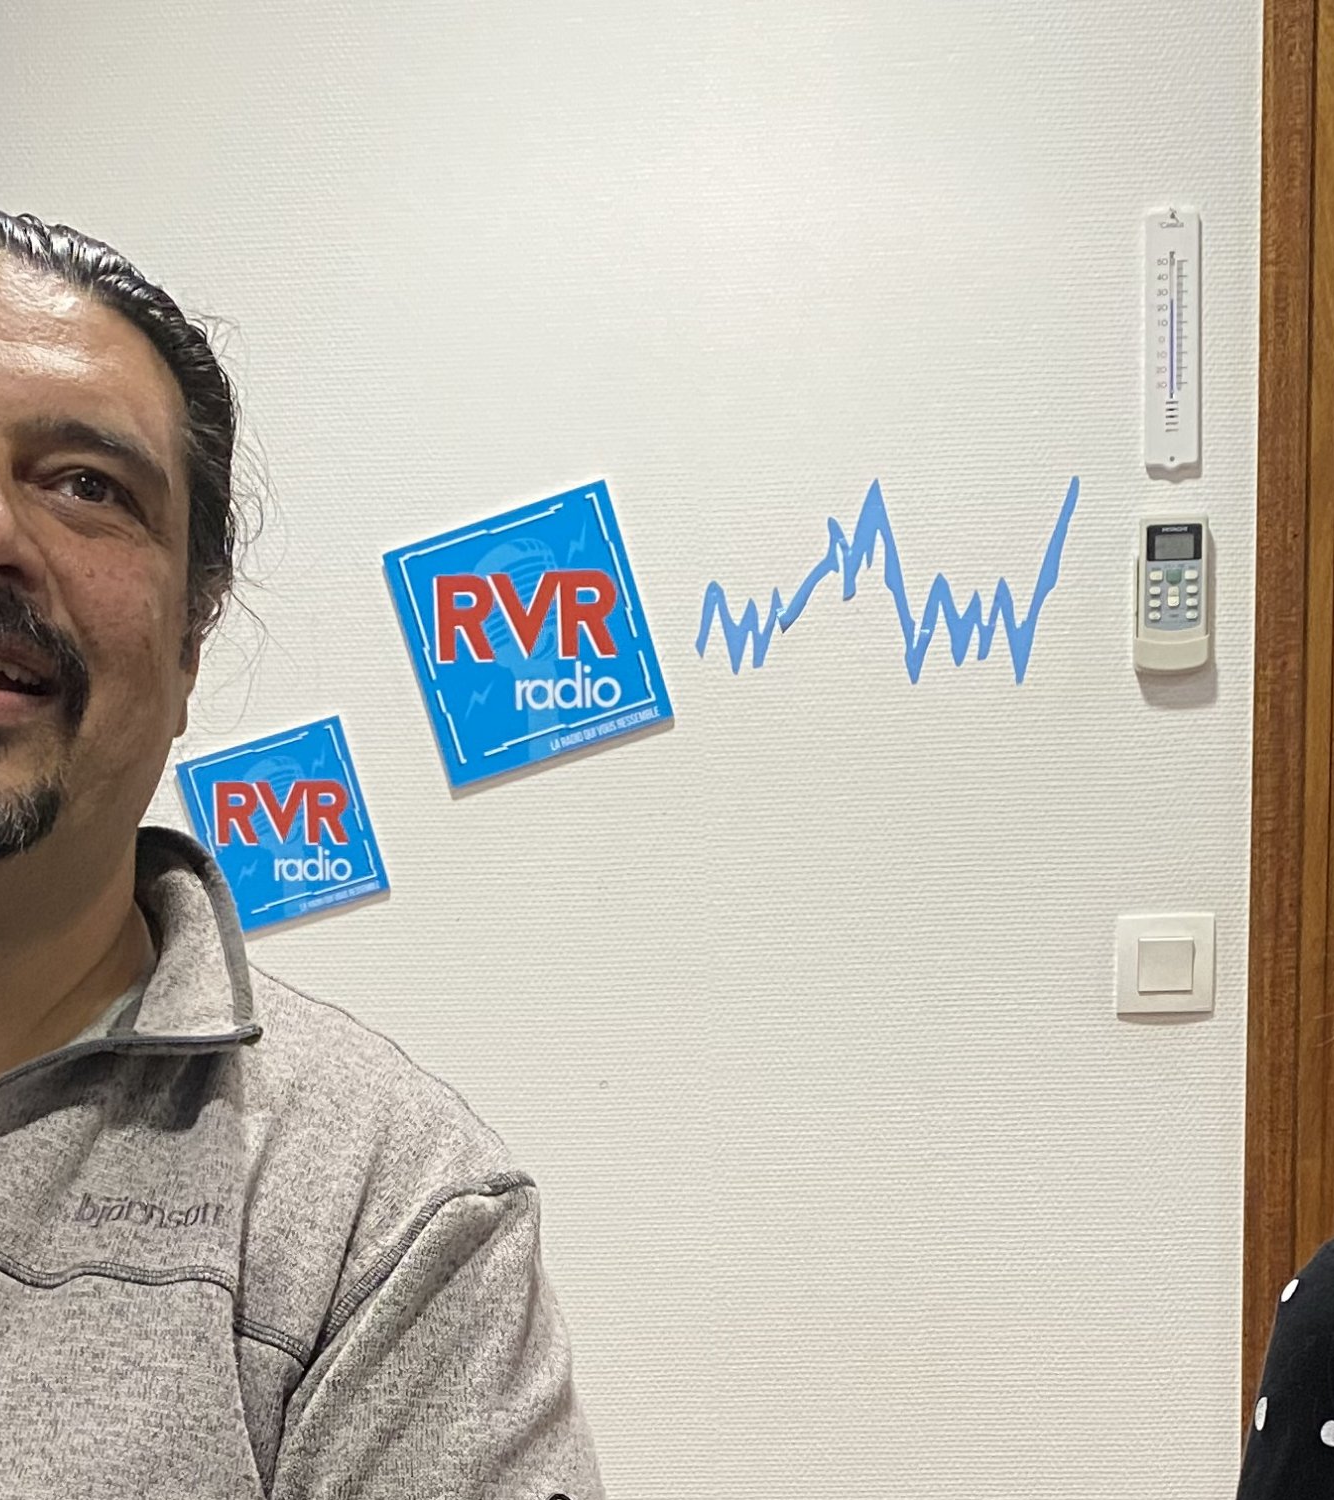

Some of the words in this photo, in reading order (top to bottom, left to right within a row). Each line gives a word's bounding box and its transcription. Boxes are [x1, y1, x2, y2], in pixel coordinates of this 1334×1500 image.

[432, 568, 618, 665] RVR
[514, 661, 622, 711] radio
[212, 780, 349, 847] RVR
[273, 847, 353, 882] radio
